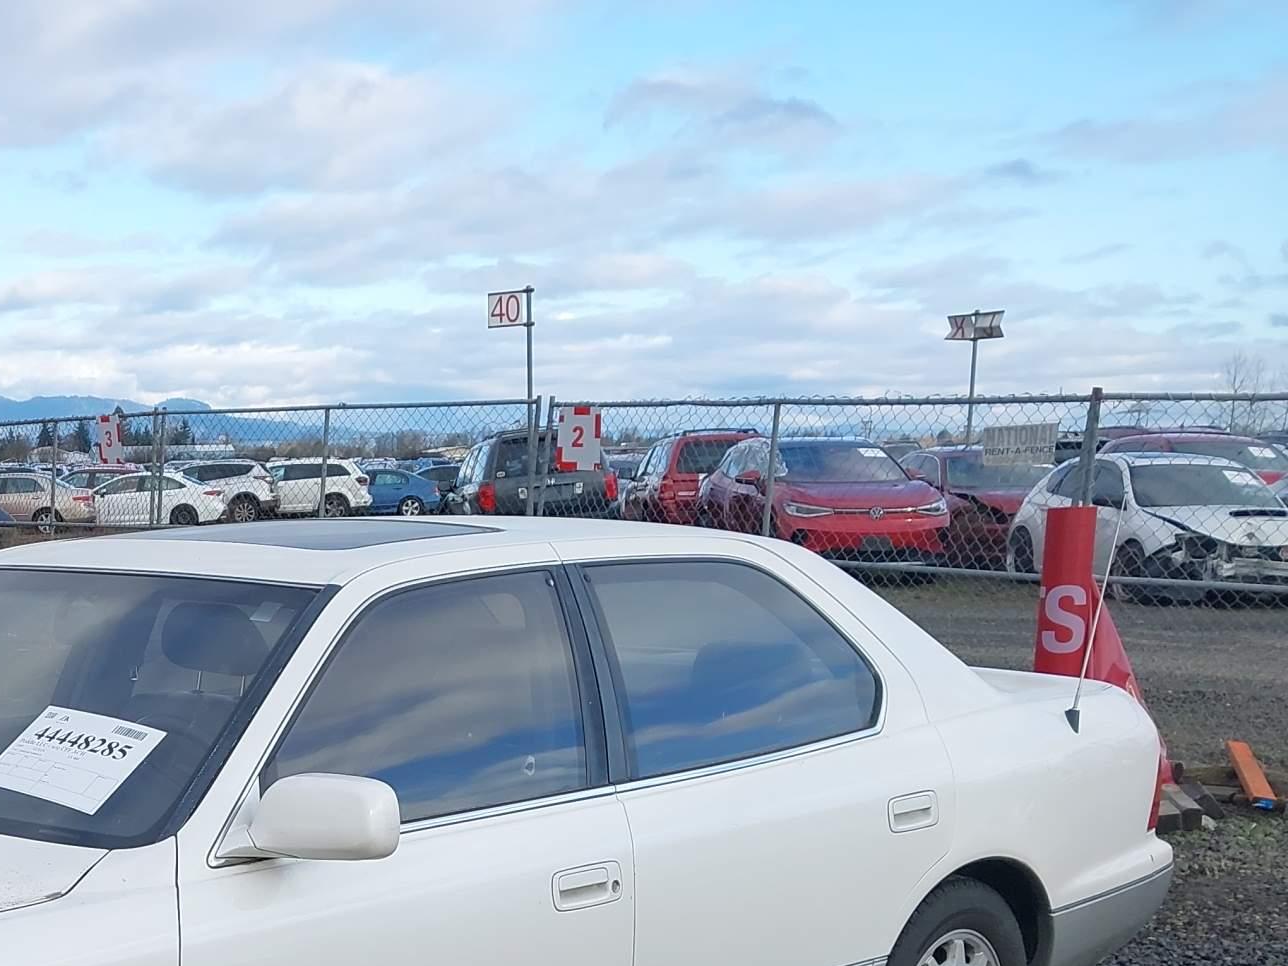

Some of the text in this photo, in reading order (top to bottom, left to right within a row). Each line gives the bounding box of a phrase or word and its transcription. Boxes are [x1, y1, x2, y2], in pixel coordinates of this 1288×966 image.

[490, 294, 520, 324] 40
[105, 431, 113, 447] 3
[571, 426, 585, 448] 2
[984, 445, 1055, 456] RENT-A-FENCE
[34, 726, 133, 760] 44448285
